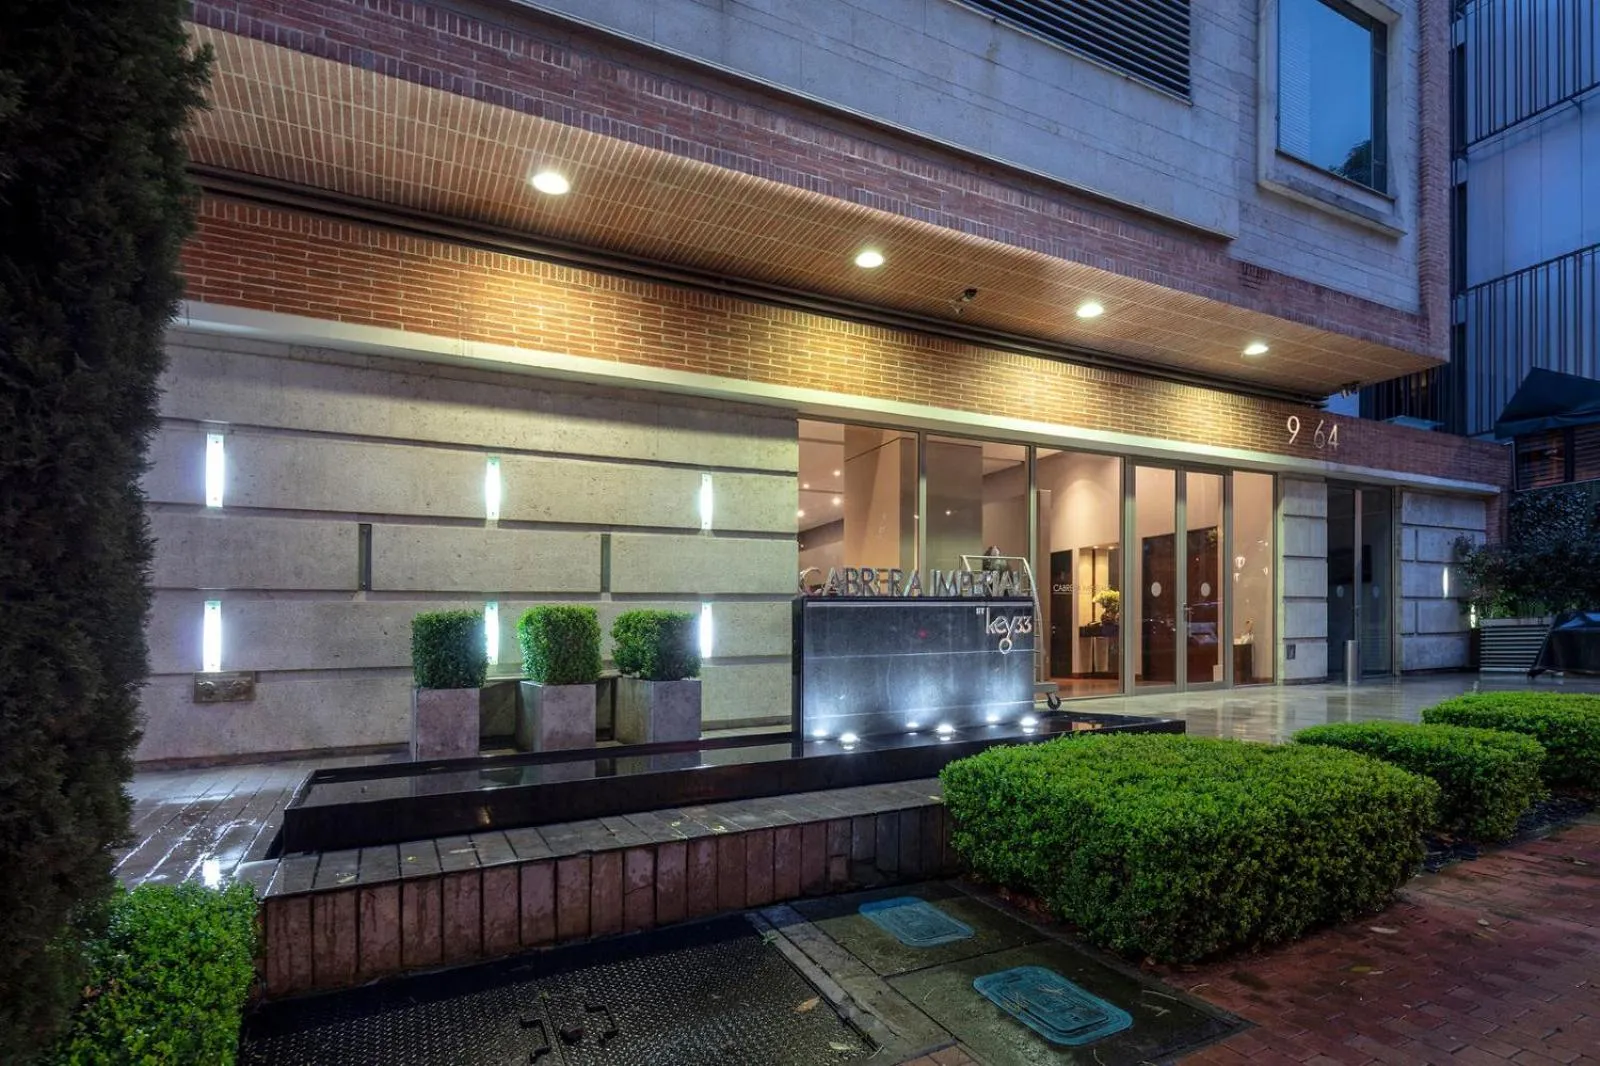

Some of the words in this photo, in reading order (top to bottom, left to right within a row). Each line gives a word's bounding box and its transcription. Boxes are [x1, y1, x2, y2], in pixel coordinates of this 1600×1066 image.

[1287, 415, 1300, 445] 9
[1313, 419, 1339, 450] 64
[799, 566, 923, 597] CABRERA
